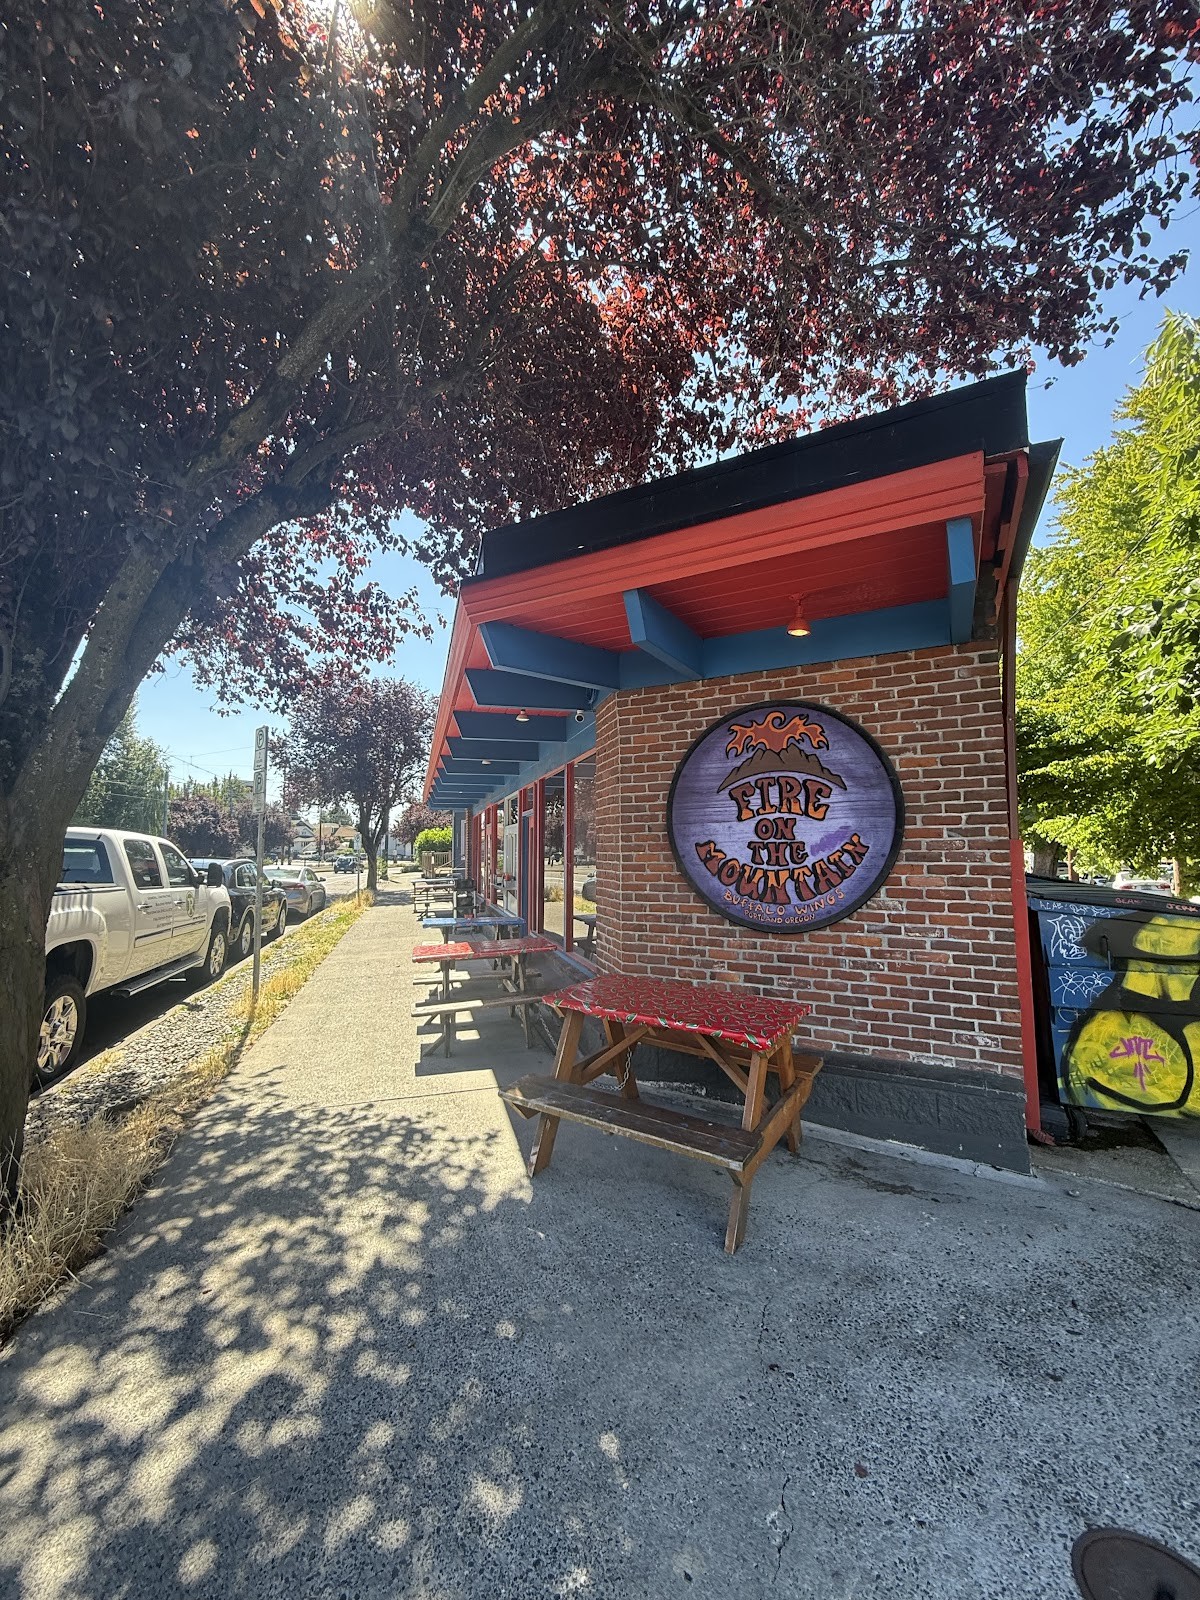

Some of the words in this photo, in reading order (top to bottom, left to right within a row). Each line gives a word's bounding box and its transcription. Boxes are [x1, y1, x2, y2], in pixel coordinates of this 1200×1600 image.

[729, 776, 832, 821] FIRE
[755, 817, 797, 840] ON
[747, 841, 809, 866] THE
[695, 833, 870, 904] MOUNTAIN
[723, 890, 785, 915] BUFFALO
[795, 888, 845, 914] WINGS
[744, 910, 783, 924] PORTLAND
[785, 914, 815, 924] OREGON
